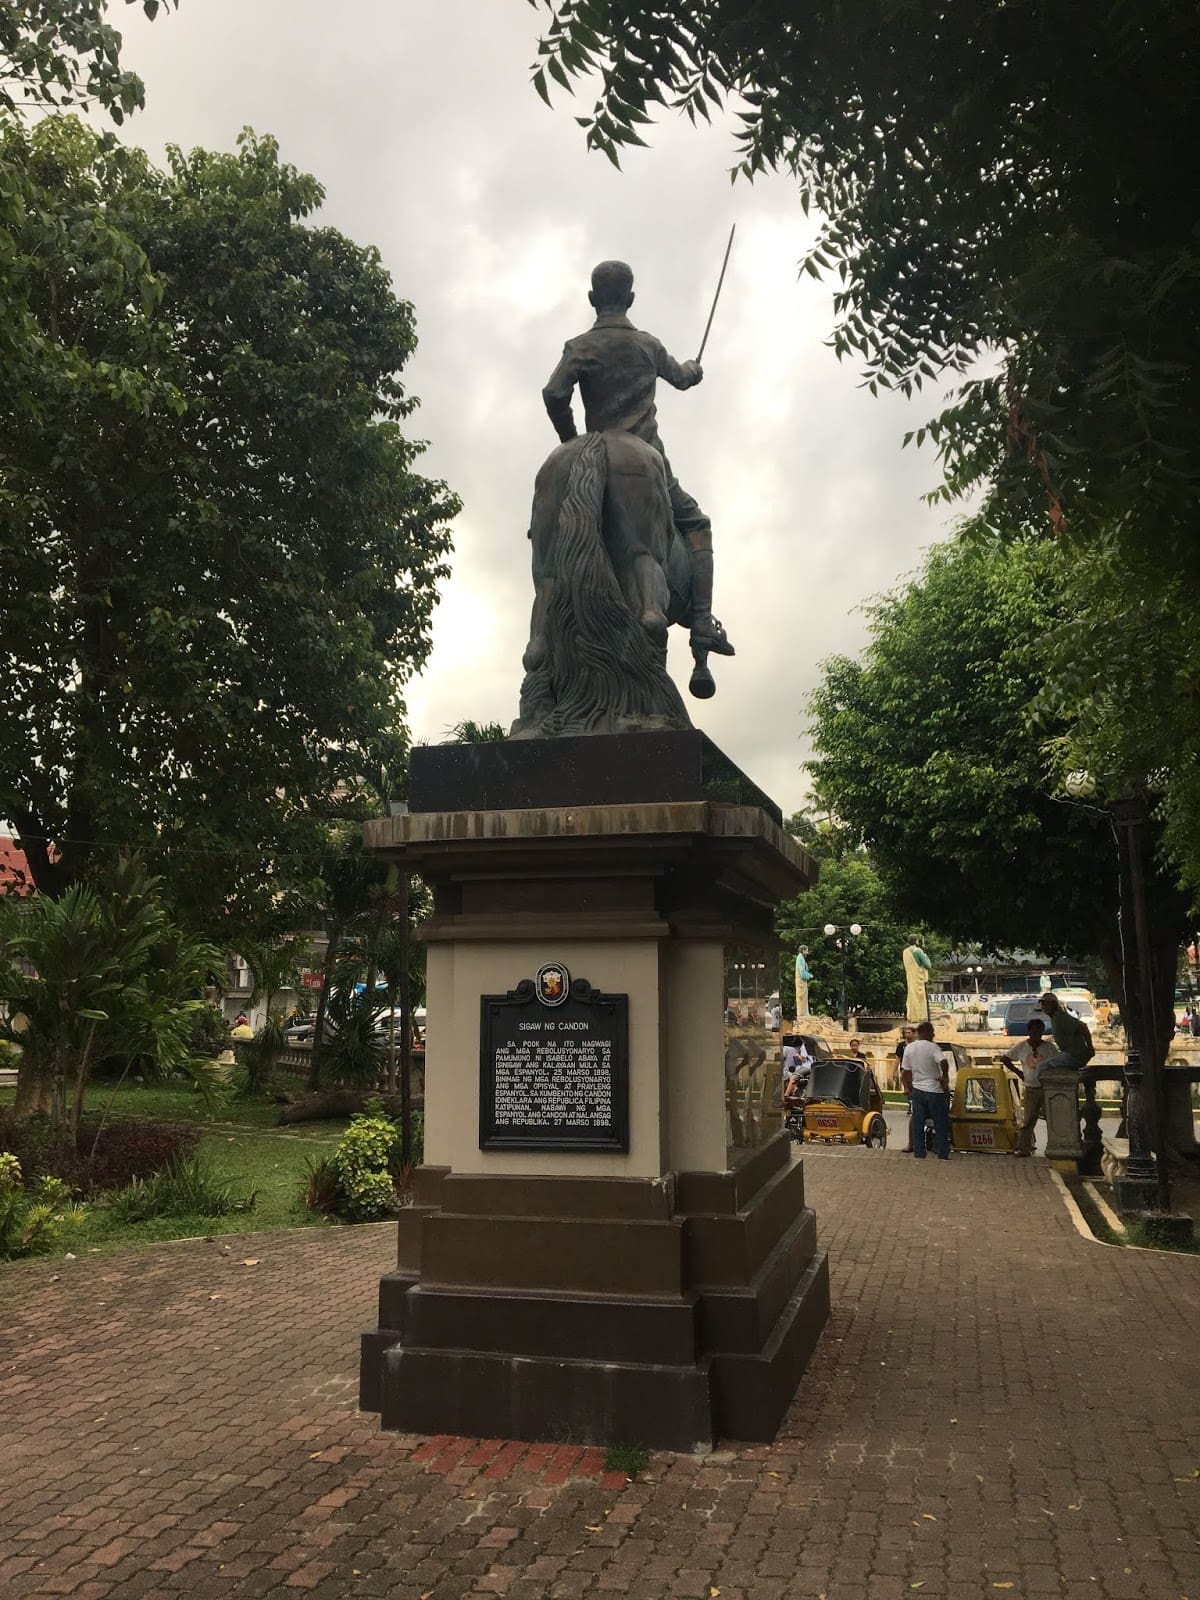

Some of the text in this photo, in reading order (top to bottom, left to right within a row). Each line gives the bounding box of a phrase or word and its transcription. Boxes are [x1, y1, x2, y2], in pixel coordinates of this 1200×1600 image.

[928, 994, 971, 1003] ARANGAY
[519, 1022, 589, 1031] SIGAW NG CANDON
[971, 1133, 993, 1145] 2266
